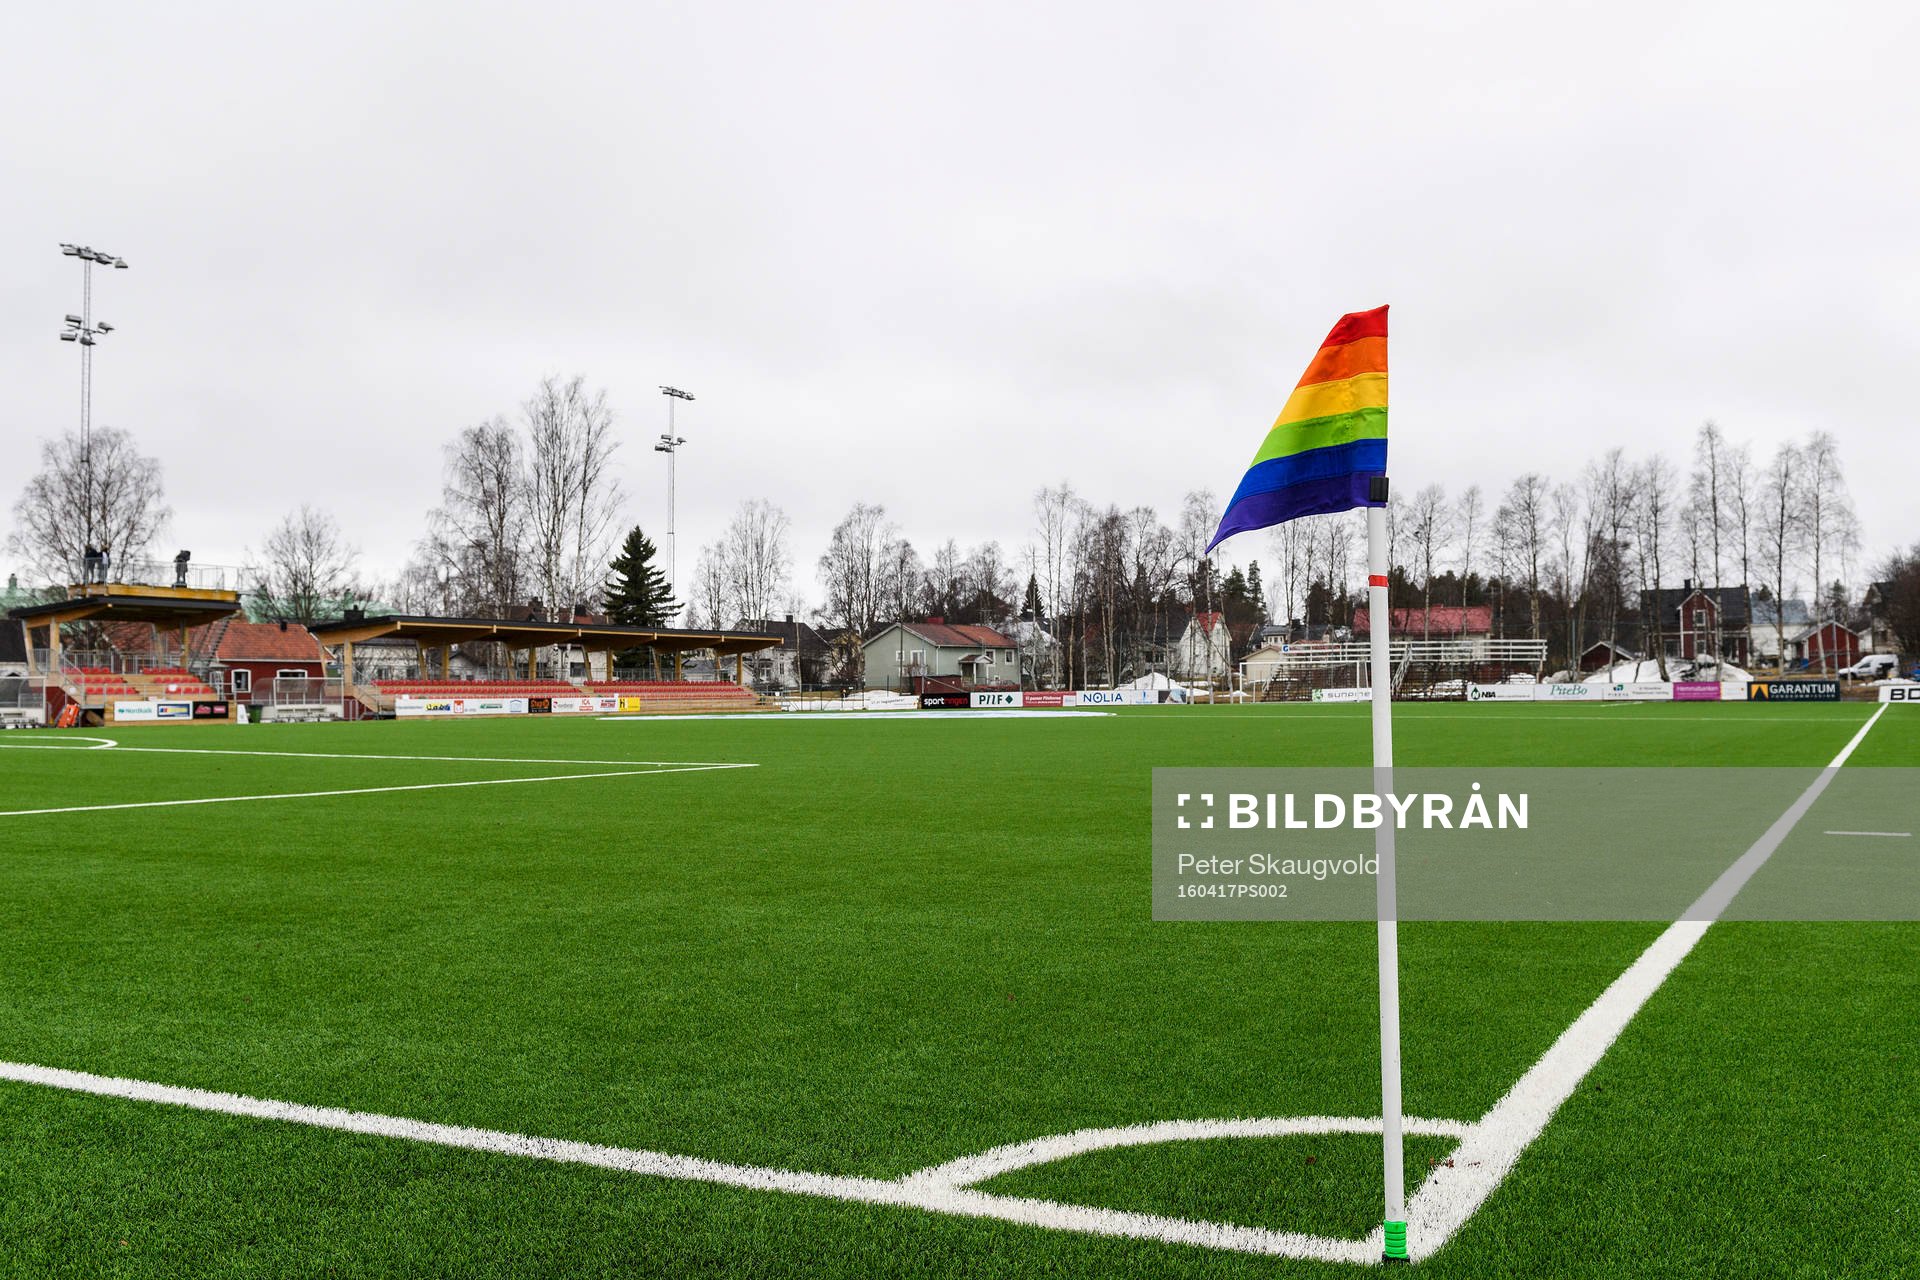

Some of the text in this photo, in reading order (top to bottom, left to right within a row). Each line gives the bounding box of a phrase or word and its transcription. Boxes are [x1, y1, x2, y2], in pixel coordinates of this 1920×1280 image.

[1550, 684, 1588, 696] PiteBo
[1769, 684, 1836, 694] GARANTUM
[1083, 692, 1123, 703] NOLIA
